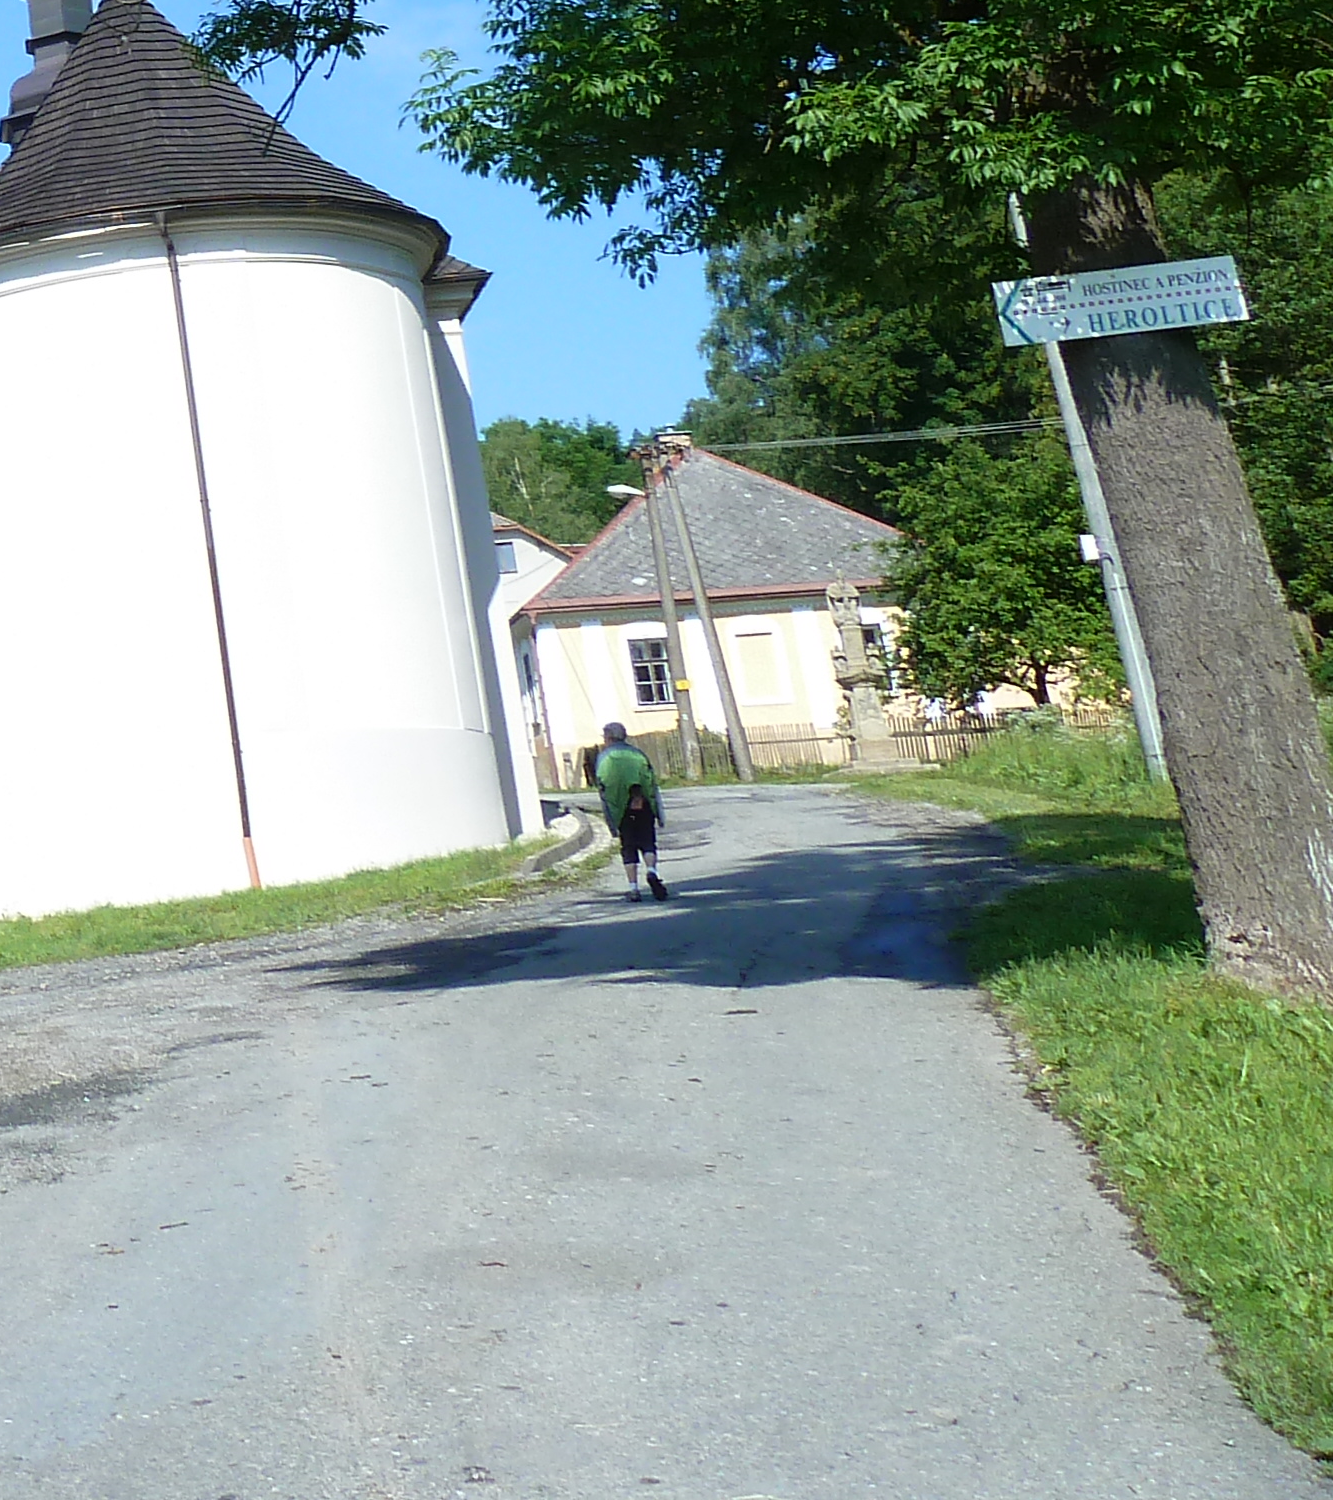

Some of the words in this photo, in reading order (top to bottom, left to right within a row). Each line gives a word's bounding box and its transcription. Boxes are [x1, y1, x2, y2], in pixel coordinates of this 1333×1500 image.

[1083, 277, 1151, 297] HOSTINEC
[1156, 276, 1165, 289] A
[1087, 297, 1237, 333] HEROLTICE
